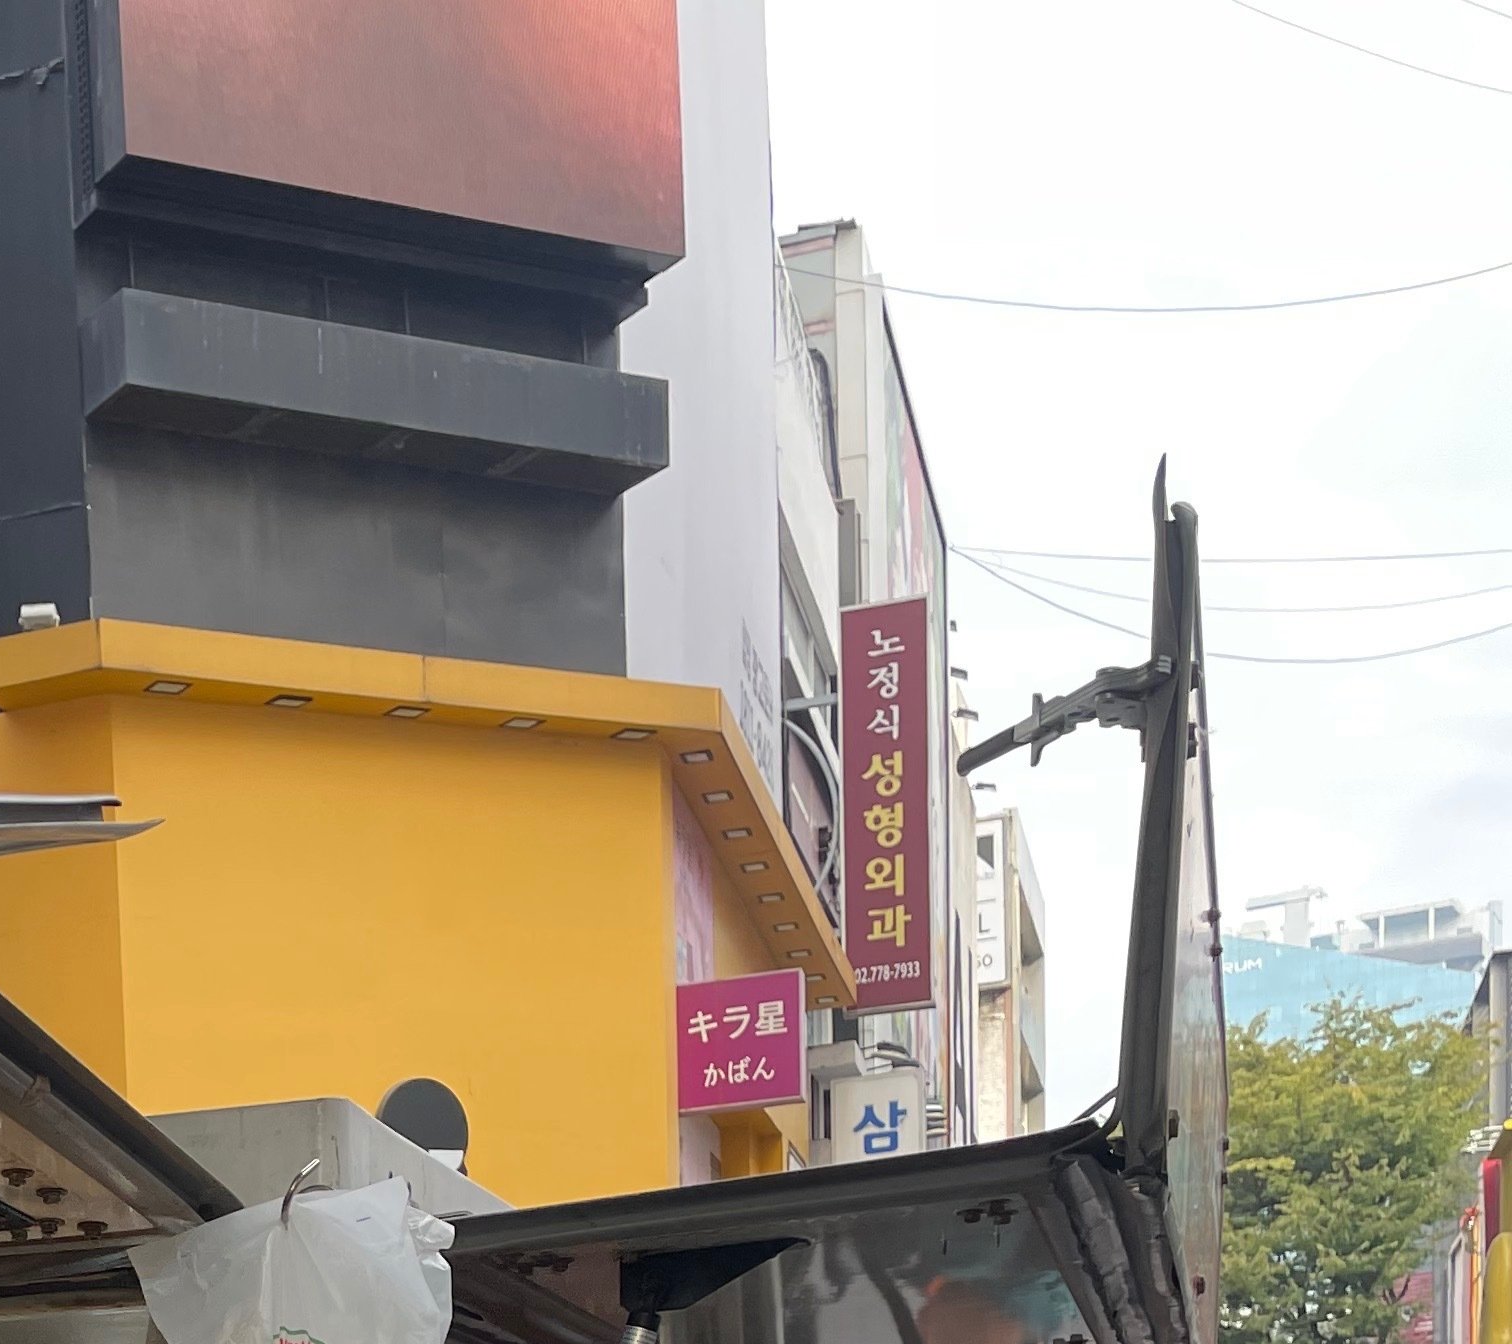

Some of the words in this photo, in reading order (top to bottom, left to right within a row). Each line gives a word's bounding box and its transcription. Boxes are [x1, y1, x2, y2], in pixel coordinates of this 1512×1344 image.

[866, 629, 906, 741] 노정식
[861, 749, 912, 948] 성형외과
[687, 1001, 788, 1043] キラ星
[703, 1056, 775, 1088] かばん
